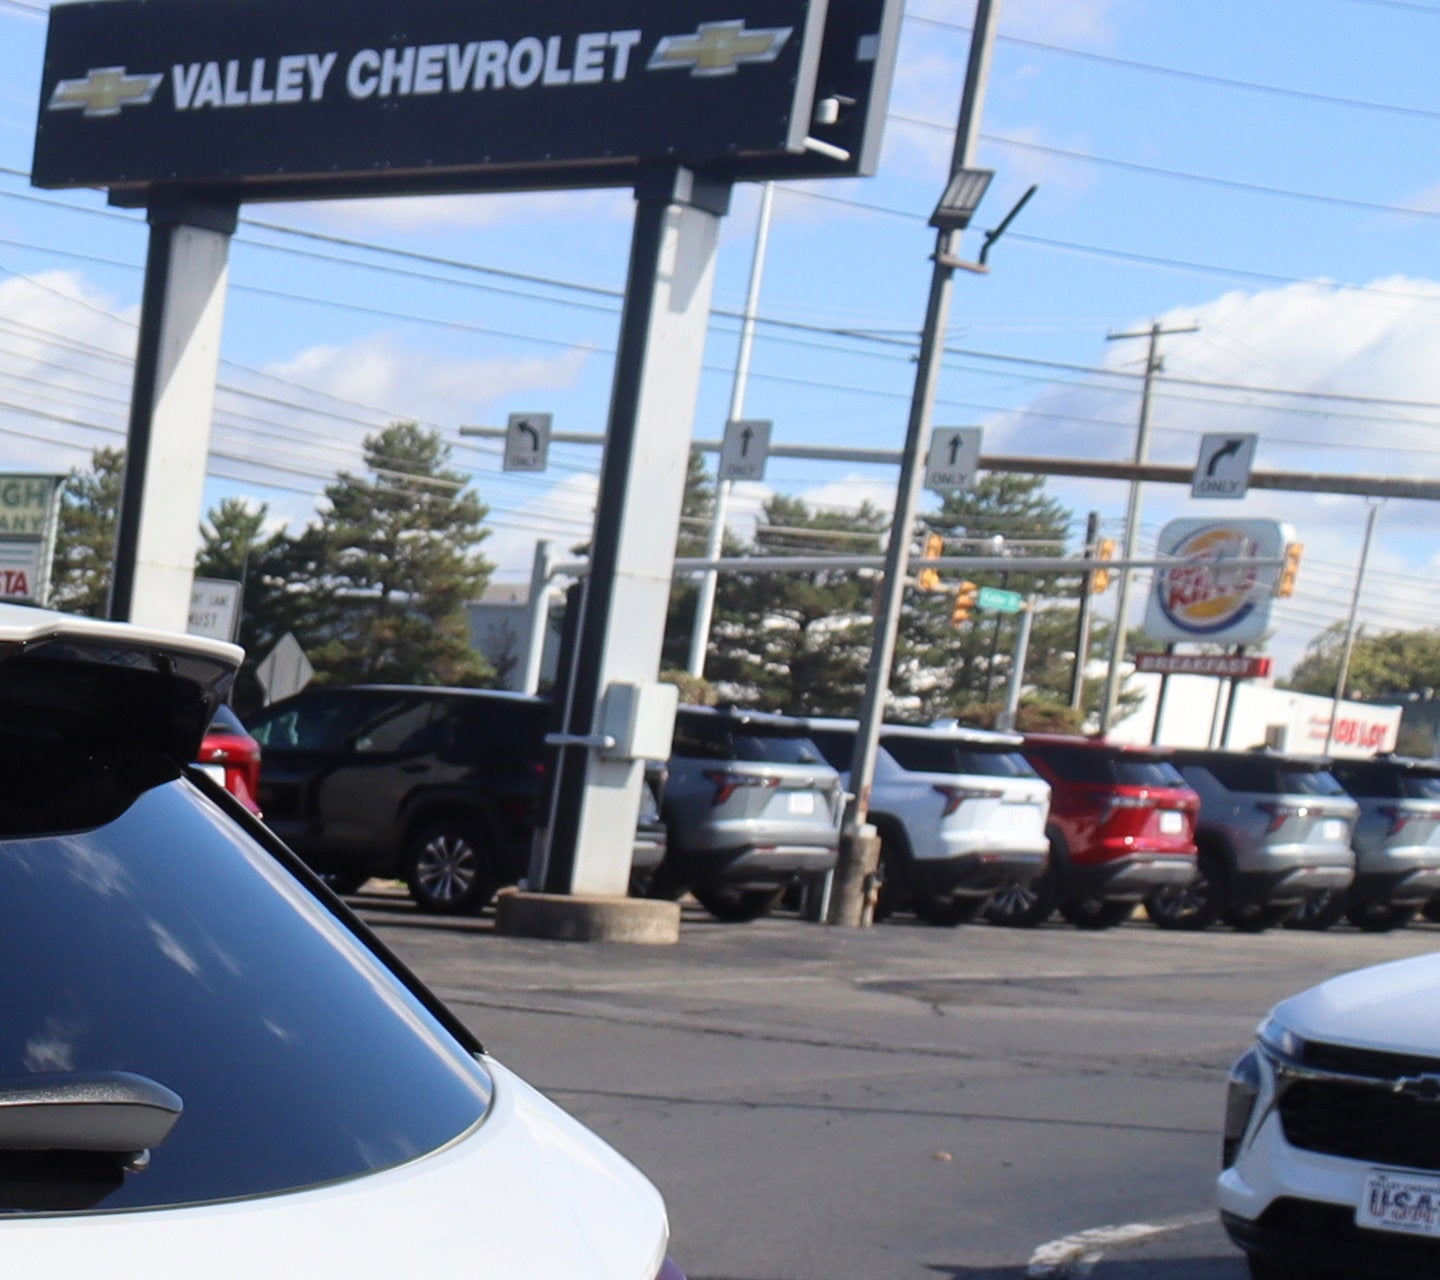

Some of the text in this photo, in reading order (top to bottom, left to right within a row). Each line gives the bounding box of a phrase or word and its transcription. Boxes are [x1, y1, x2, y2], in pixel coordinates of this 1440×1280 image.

[172, 28, 642, 111] VALLEY CHEVROLET
[931, 471, 969, 485] ONLY
[1200, 479, 1241, 493] ONLY
[1141, 656, 1252, 675] BREAKFAST
